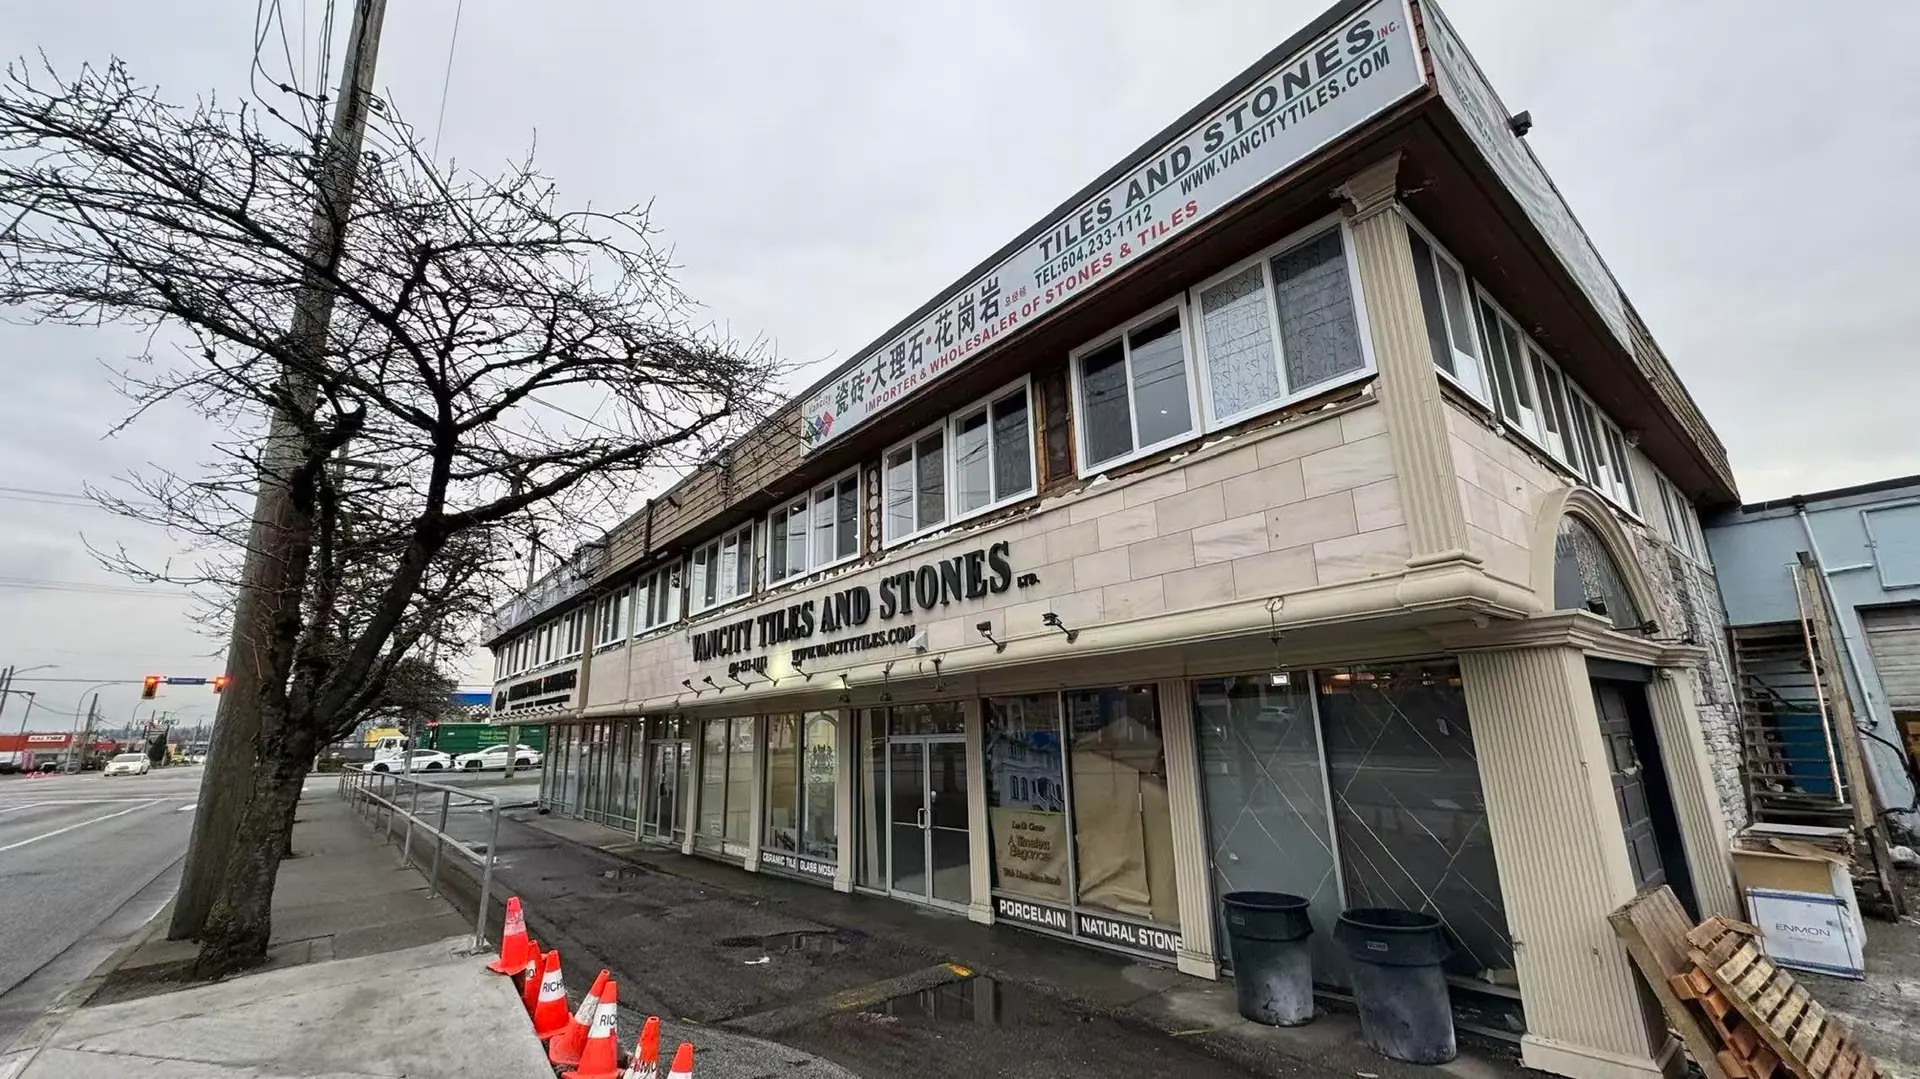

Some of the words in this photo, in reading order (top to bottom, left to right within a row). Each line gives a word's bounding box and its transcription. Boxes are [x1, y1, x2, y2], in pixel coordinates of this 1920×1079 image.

[1180, 46, 1391, 196] WWW.VANCITYTILES.COM
[1039, 198, 1113, 262] TILES
[1125, 145, 1192, 209] AND
[1203, 20, 1375, 154] STONES
[1376, 22, 1400, 41] INC.
[1035, 204, 1153, 288] TEL:604.233-1112
[865, 375, 917, 413] IMPORTER
[919, 367, 928, 381] &
[929, 311, 1018, 374] WHOLESALER
[1022, 296, 1041, 318] OF
[1045, 252, 1113, 304] STONES
[1119, 242, 1132, 259] &
[1137, 200, 1198, 247] TILES
[692, 619, 754, 662] VANCITY
[757, 600, 814, 648] TILES
[819, 585, 871, 633] AND
[879, 540, 1012, 620] STONES
[792, 625, 916, 661] WWW.VANCITYTILES.COM
[763, 852, 785, 866] CERAMIC
[786, 855, 796, 868] TILE
[800, 860, 818, 873] GLASS
[1000, 899, 1066, 928] PORCELAIN
[1081, 917, 1136, 943] NATURAL
[1775, 922, 1831, 937] ENMON
